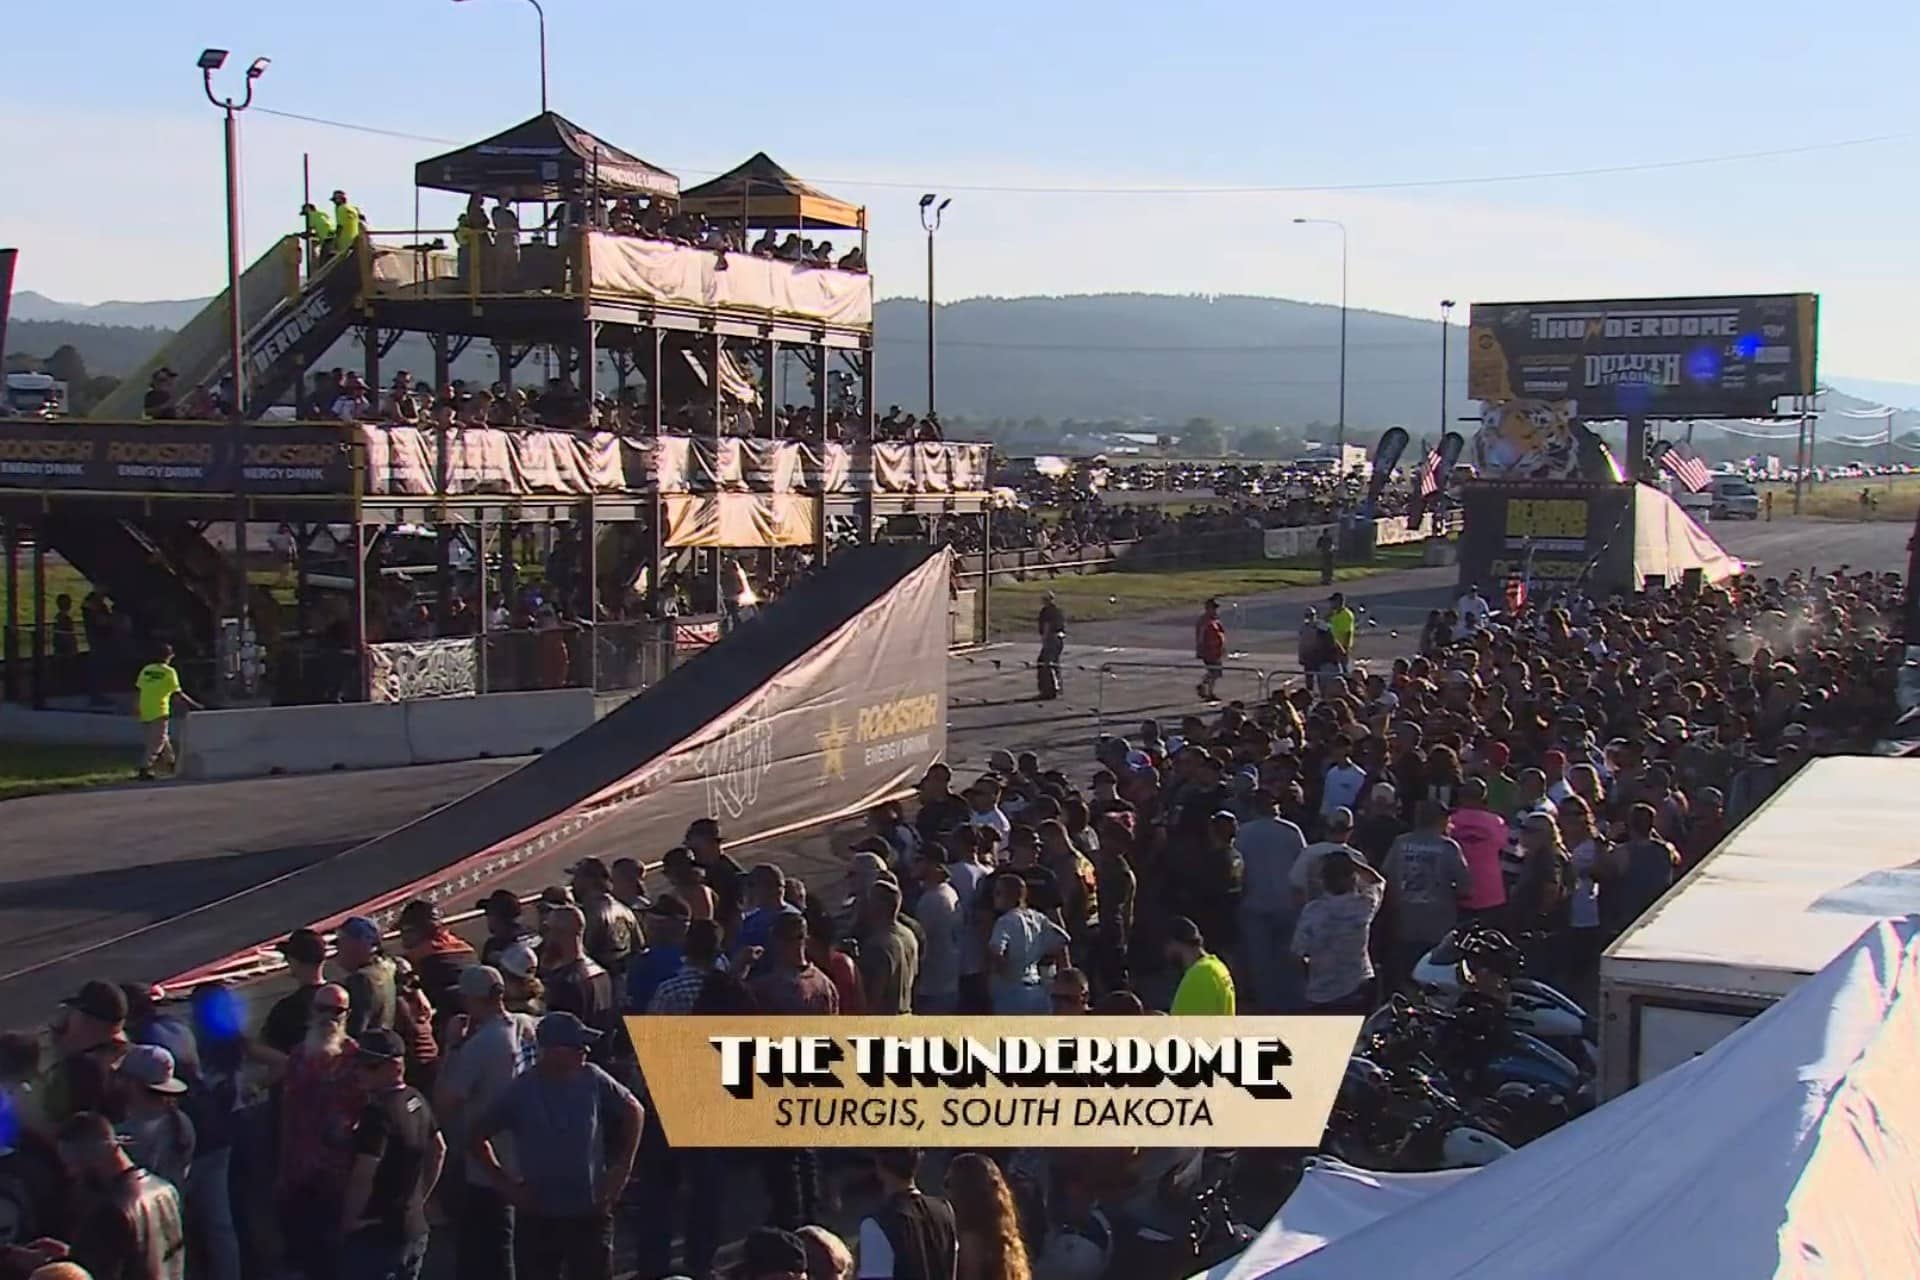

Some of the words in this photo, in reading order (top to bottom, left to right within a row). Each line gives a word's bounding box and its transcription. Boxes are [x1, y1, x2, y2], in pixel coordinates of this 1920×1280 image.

[1584, 353, 1680, 387] DULUTH
[1600, 369, 1662, 385] TRADING
[106, 441, 213, 464] ROCKSTAR
[118, 464, 163, 478] ENERGY
[164, 465, 203, 478] DRINK
[287, 468, 324, 480] DRINK
[856, 693, 939, 743] ROCKSTAR
[864, 742, 902, 766] ENERGY
